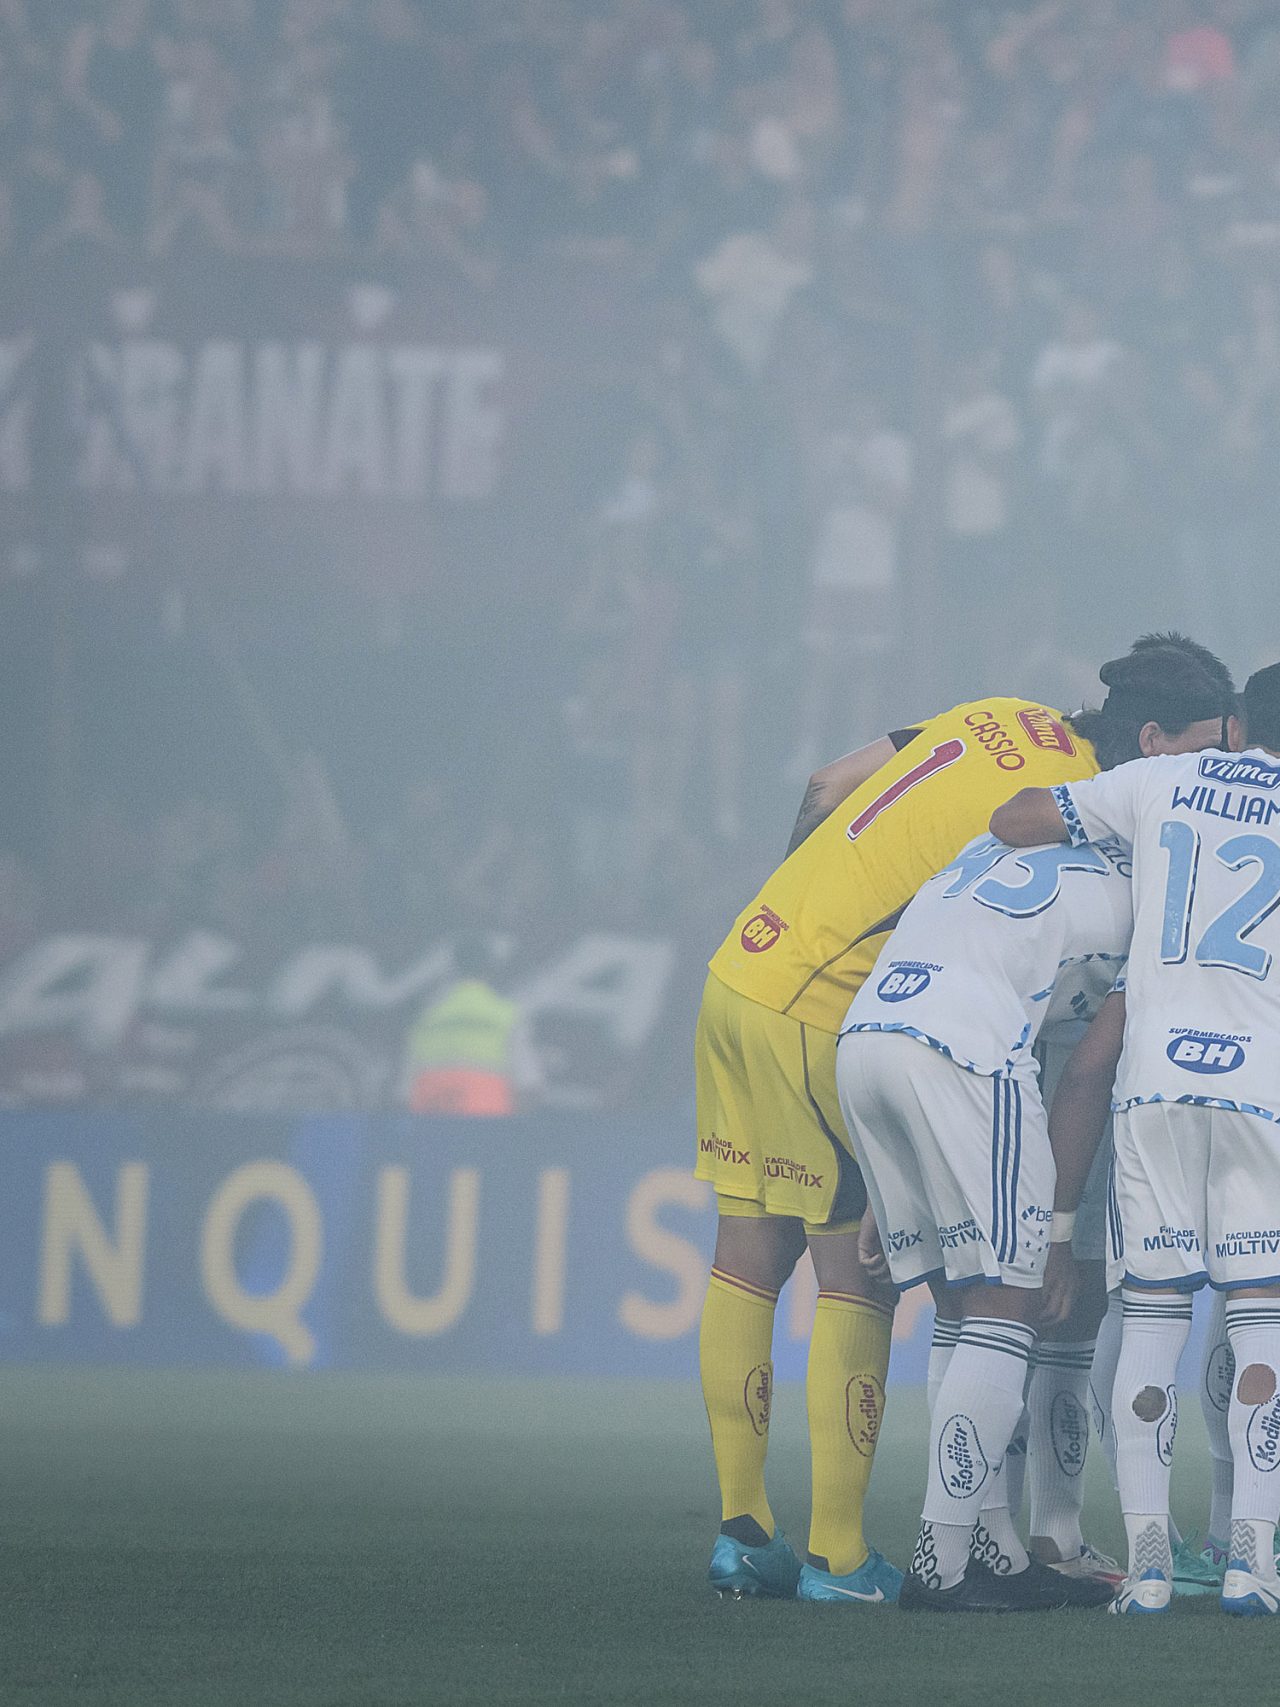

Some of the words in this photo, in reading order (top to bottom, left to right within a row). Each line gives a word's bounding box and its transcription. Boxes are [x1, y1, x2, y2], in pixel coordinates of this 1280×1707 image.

[1203, 758, 1278, 786] Vilma
[846, 738, 967, 842] 1
[743, 918, 779, 949] BH
[880, 973, 928, 994] BH
[1169, 1028, 1252, 1043] SUPERMERCADOS
[1173, 1041, 1238, 1066] BH
[858, 1380, 878, 1444] Kodilar
[946, 1421, 974, 1491] Kodilar
